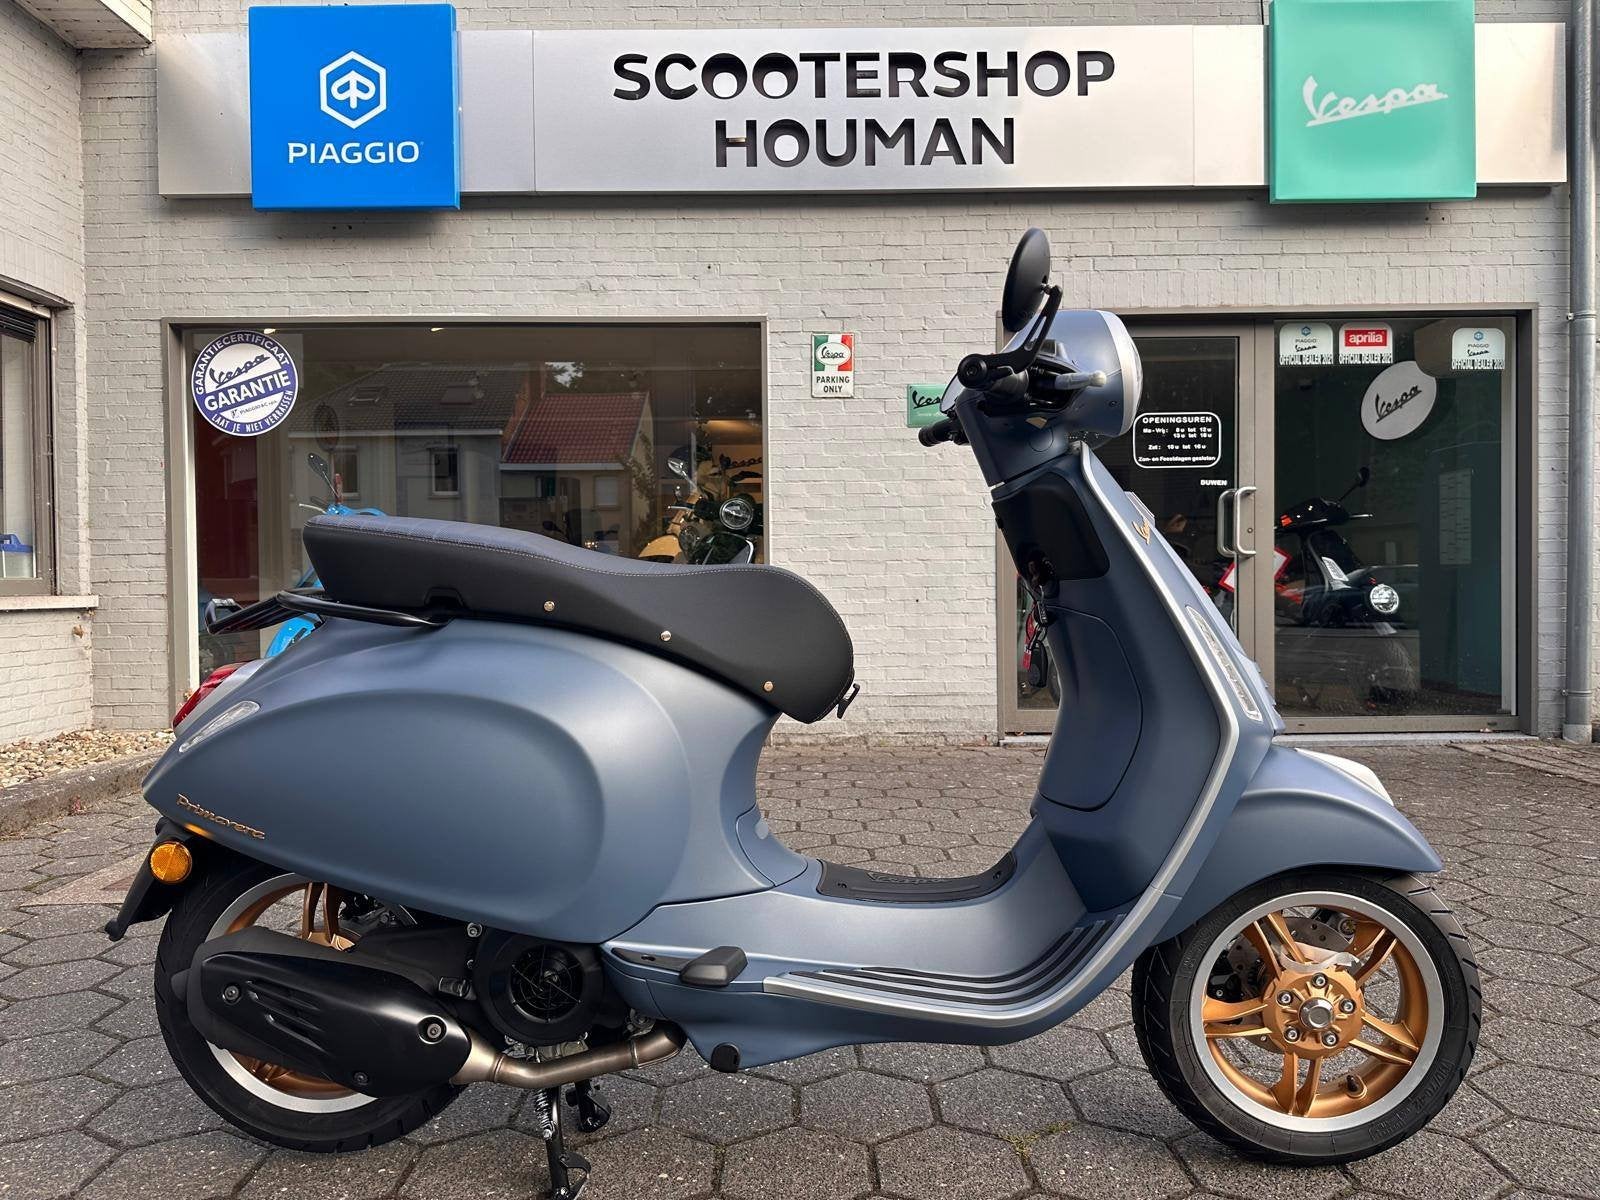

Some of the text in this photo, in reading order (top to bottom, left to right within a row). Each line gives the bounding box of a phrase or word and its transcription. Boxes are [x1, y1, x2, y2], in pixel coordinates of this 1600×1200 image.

[613, 50, 1115, 100] SCOOTERSHOP
[1302, 75, 1449, 127] Vespa
[287, 141, 420, 164] PIAGGIO
[715, 117, 1015, 168] HOUMAN
[820, 346, 845, 359] Vespa
[1349, 331, 1383, 345] aprilia
[196, 333, 290, 395] GARANTIECERTIFICAAT
[209, 354, 271, 388] Vespa
[1280, 354, 1301, 366] OFFICIAL
[1302, 354, 1321, 365] DEALER
[1339, 353, 1360, 364] OFFICIAL
[1362, 353, 1380, 364] DEALER
[1452, 360, 1474, 370] OFFICIAL
[1474, 360, 1493, 370] DEALER
[204, 370, 291, 411] GARANTIE
[816, 376, 850, 384] PARKING
[212, 390, 294, 433] LAAT JE NIET VERRASSEN
[912, 390, 941, 410] Ves
[1375, 385, 1422, 423] Vespa
[176, 793, 266, 840] Primavera
